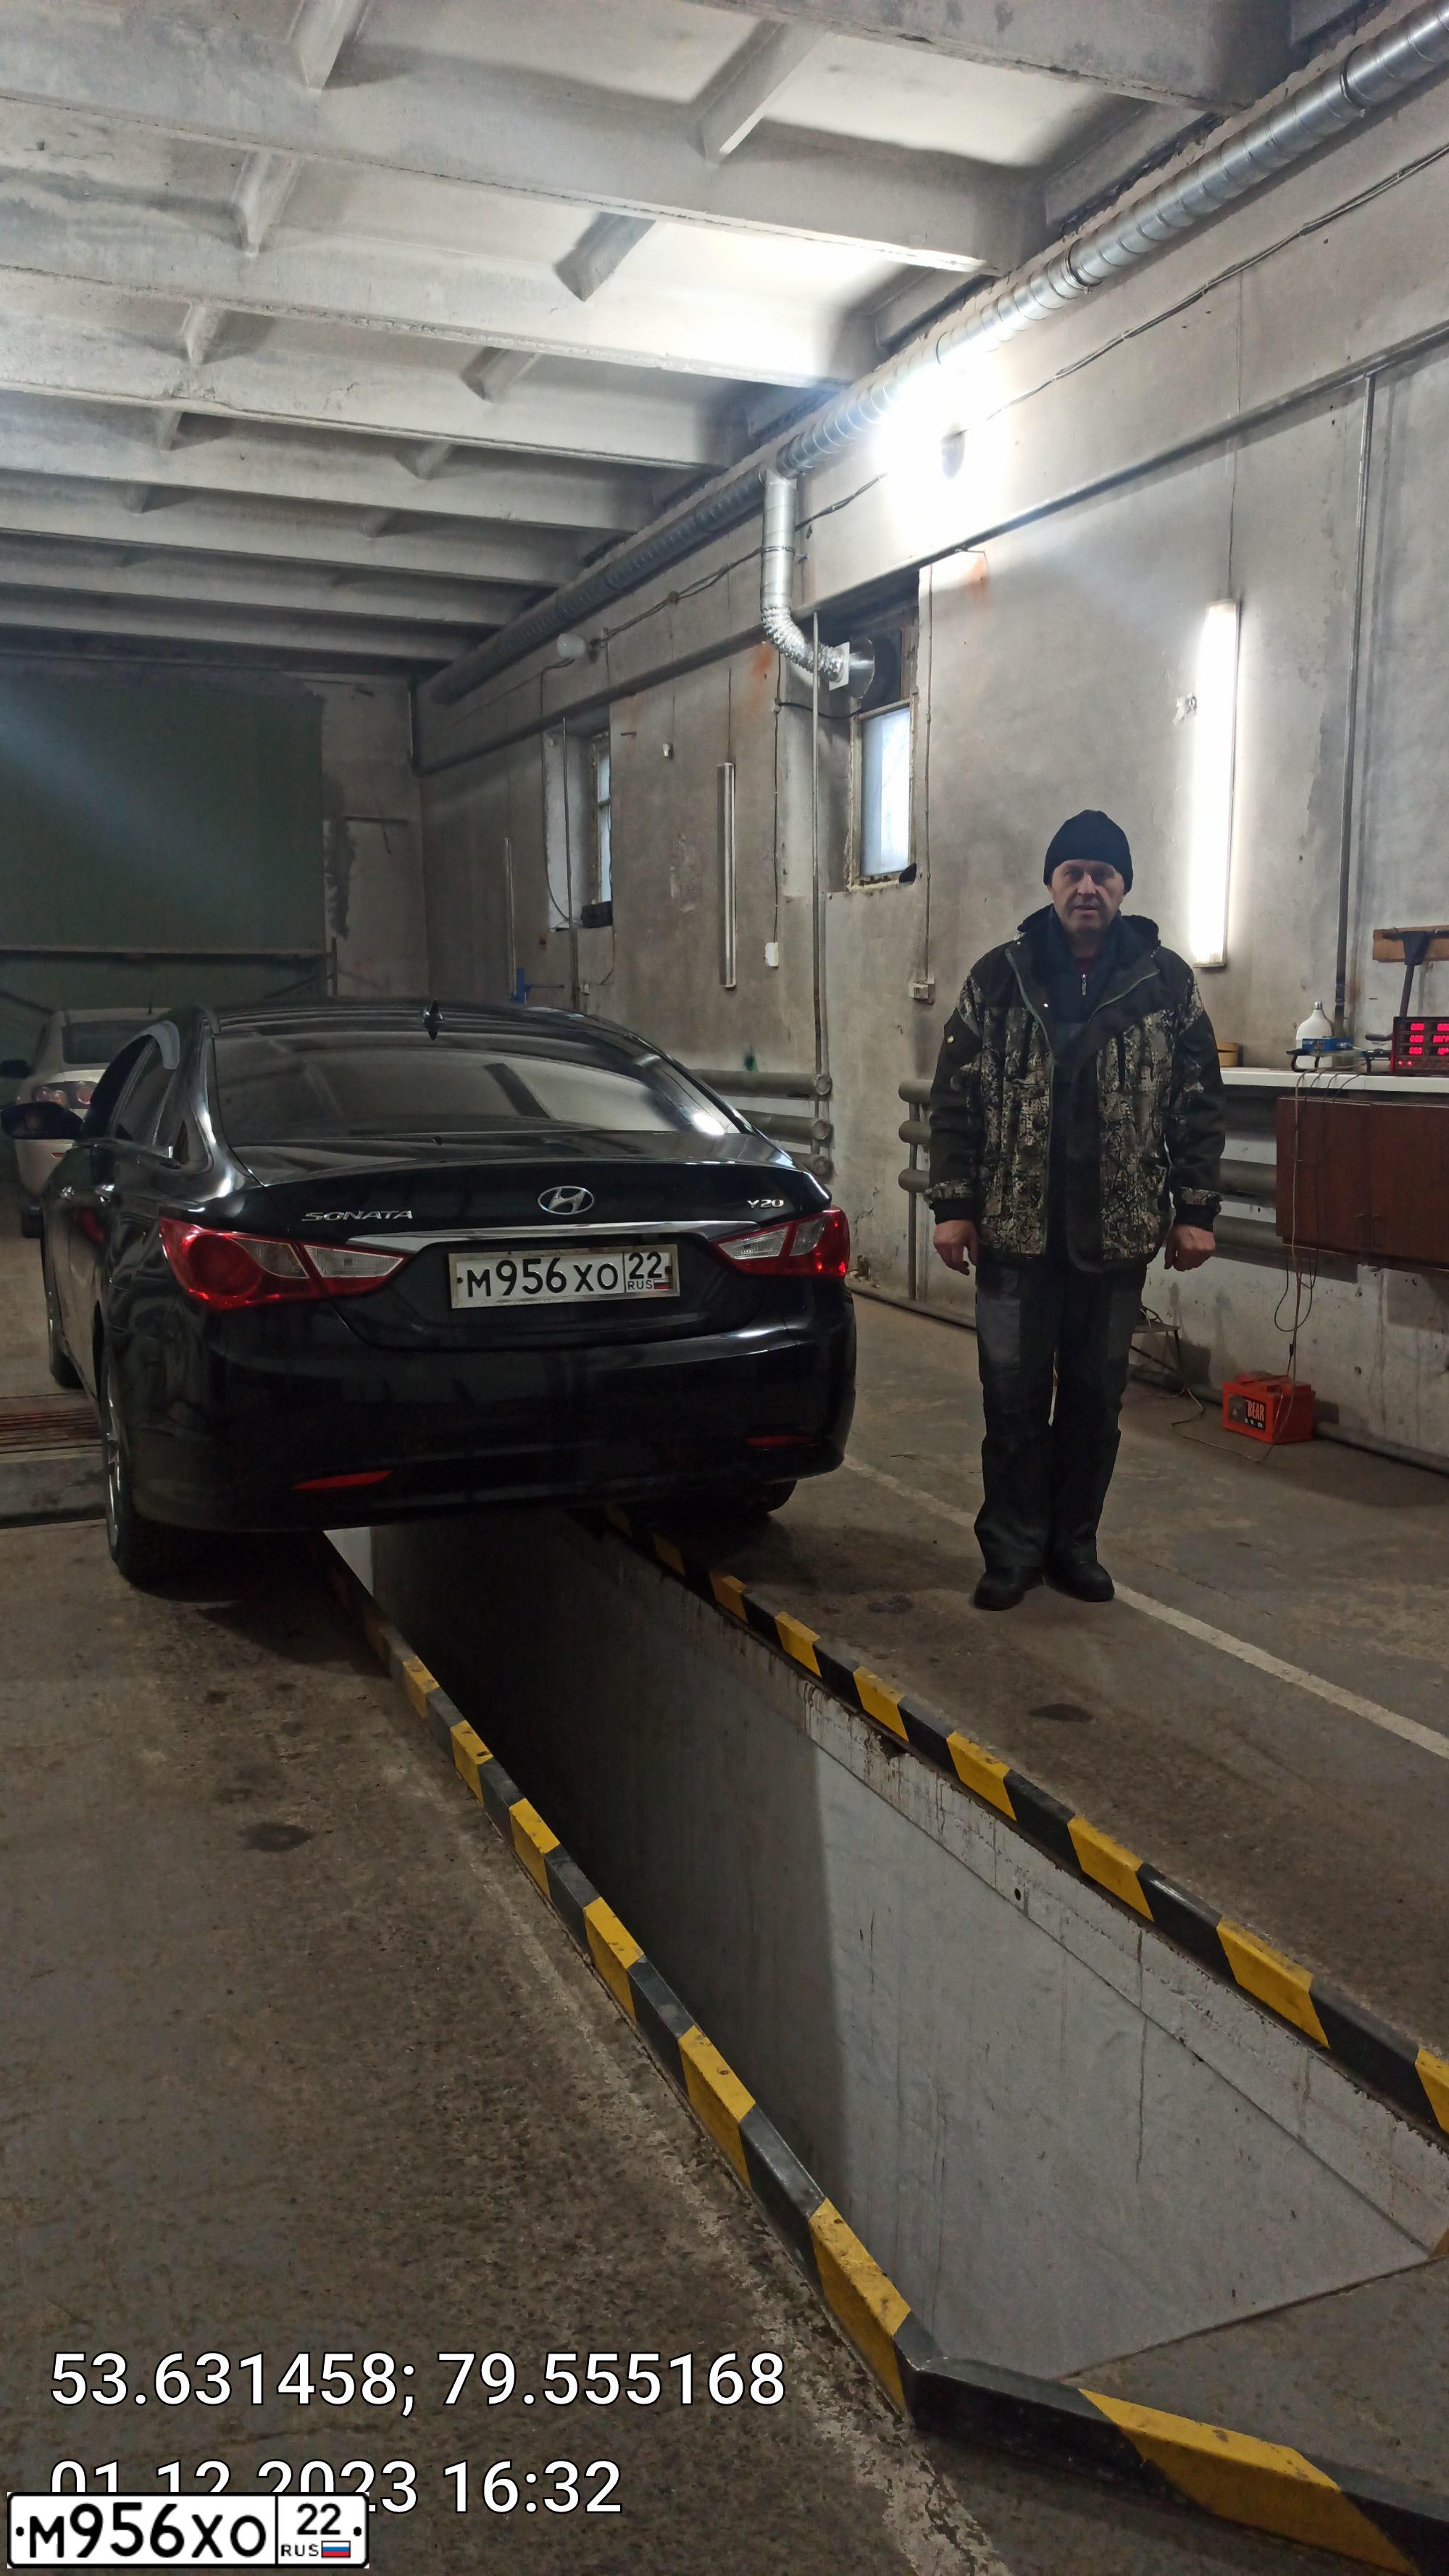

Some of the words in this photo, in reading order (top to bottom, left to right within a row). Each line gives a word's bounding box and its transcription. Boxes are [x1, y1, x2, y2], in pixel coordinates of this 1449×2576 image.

[747, 1199, 784, 1209] Y20
[301, 1210, 413, 1221] SONATA
[628, 1251, 662, 1279] 22
[627, 1279, 652, 1289] RUS
